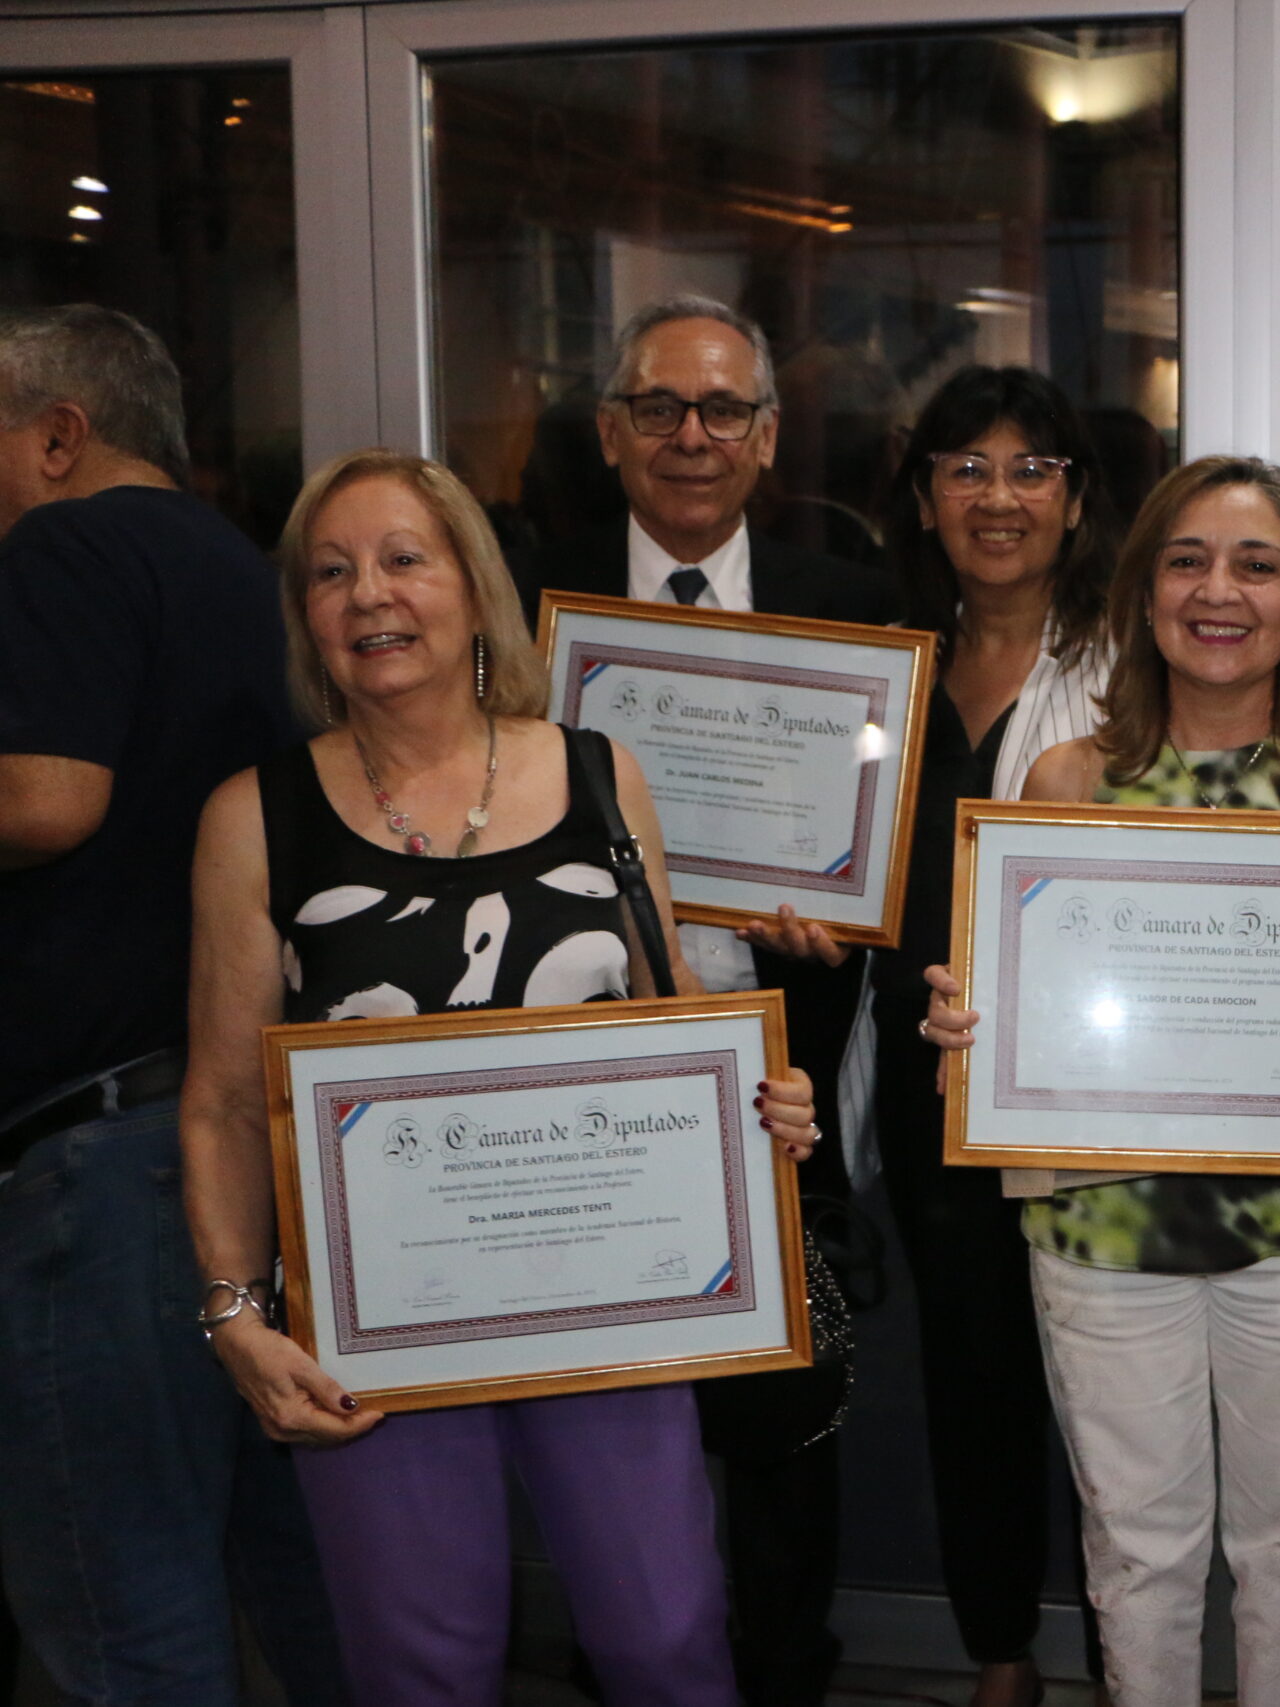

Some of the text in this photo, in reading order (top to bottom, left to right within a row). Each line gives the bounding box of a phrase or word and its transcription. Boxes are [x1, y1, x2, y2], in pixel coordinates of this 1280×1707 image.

[652, 685, 729, 722] Cámara
[734, 707, 749, 724] de
[755, 695, 850, 737] Diputados
[650, 724, 805, 750] PROVINCIA DE SANTIAGO DEL ESTERO
[1106, 898, 1202, 939] Cámara
[1207, 915, 1224, 935] de
[1108, 944, 1160, 954] PROVINCIA
[1165, 945, 1177, 954] DE
[1180, 946, 1232, 956] SANTIAGO
[1234, 947, 1252, 957] DEL
[1137, 994, 1256, 1006] SABOR DE CADA EMOCION
[437, 1113, 543, 1160] Cámara
[549, 1121, 568, 1141] de
[574, 1097, 700, 1149] Diputados
[444, 1147, 648, 1173] PROVINCIA DE SANTIAGO DEL ESTERO
[468, 1202, 612, 1224] Dra. MARIA MERCEDES TENTI
